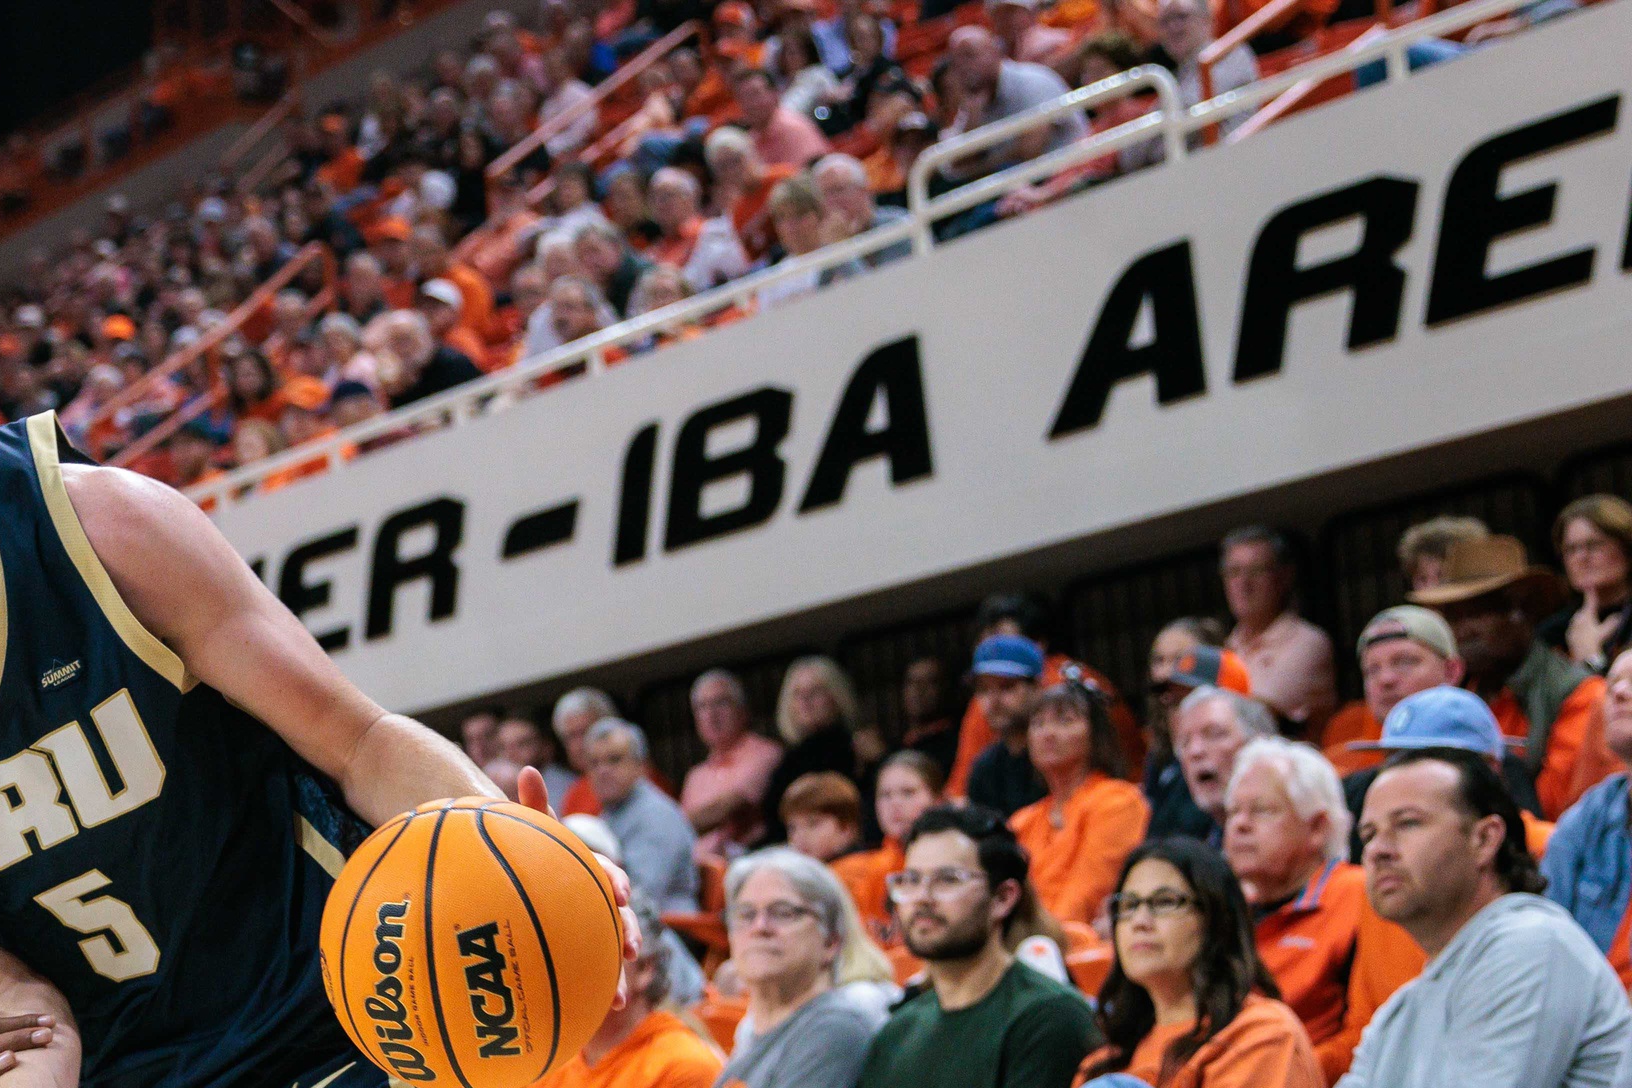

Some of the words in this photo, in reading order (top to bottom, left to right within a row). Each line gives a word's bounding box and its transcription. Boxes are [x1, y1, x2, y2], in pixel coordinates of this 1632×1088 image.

[1046, 92, 1632, 440] ARE
[249, 333, 934, 654] ER-IBA
[41, 659, 81, 688] SUMMIT
[33, 867, 161, 983] 5
[365, 899, 438, 1083] Wilson
[456, 921, 522, 1058] NCAA
[504, 919, 517, 957] BALL
